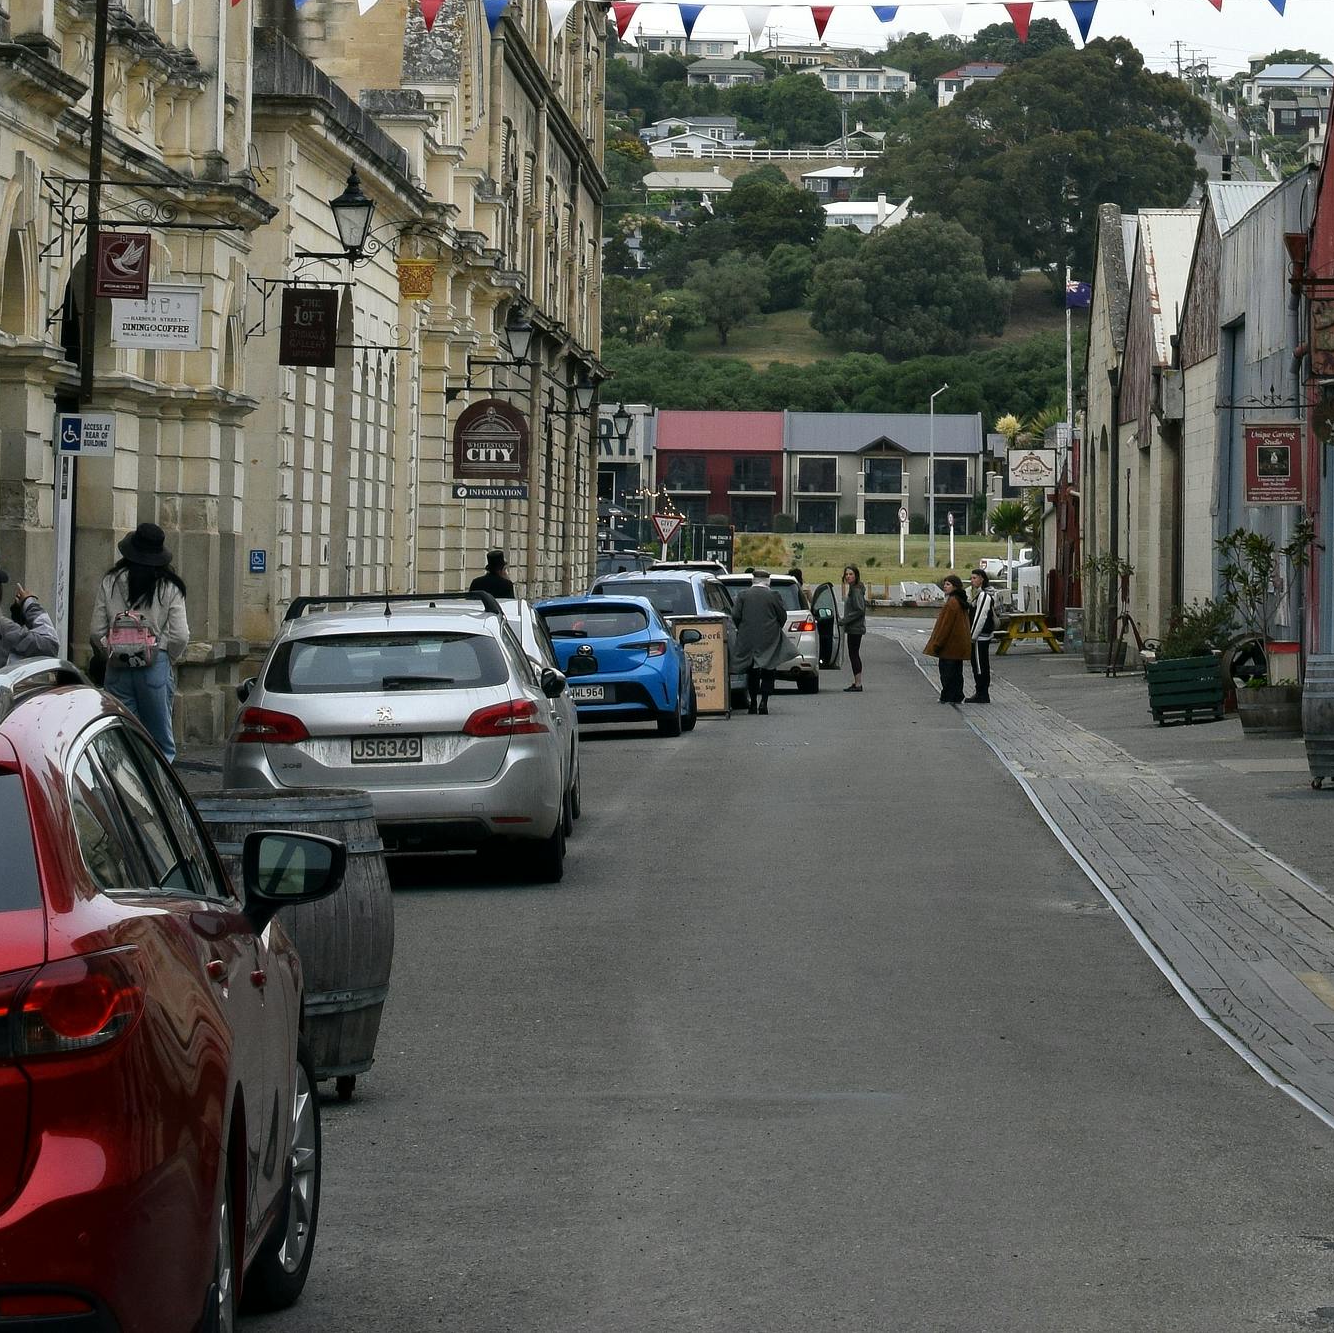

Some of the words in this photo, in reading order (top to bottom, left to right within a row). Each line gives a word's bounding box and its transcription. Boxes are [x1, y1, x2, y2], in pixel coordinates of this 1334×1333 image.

[293, 305, 325, 326] LOFT
[122, 322, 150, 332] DINING
[158, 324, 190, 333] COFFEE
[83, 423, 102, 431] ACCESS
[85, 431, 100, 439] REAR
[1251, 431, 1271, 440] Unique
[1272, 430, 1295, 441] Carving
[83, 439, 108, 447] BUILDING
[466, 448, 514, 462] CITY
[469, 487, 523, 496] INFORMATION
[354, 738, 419, 758] JSG349
